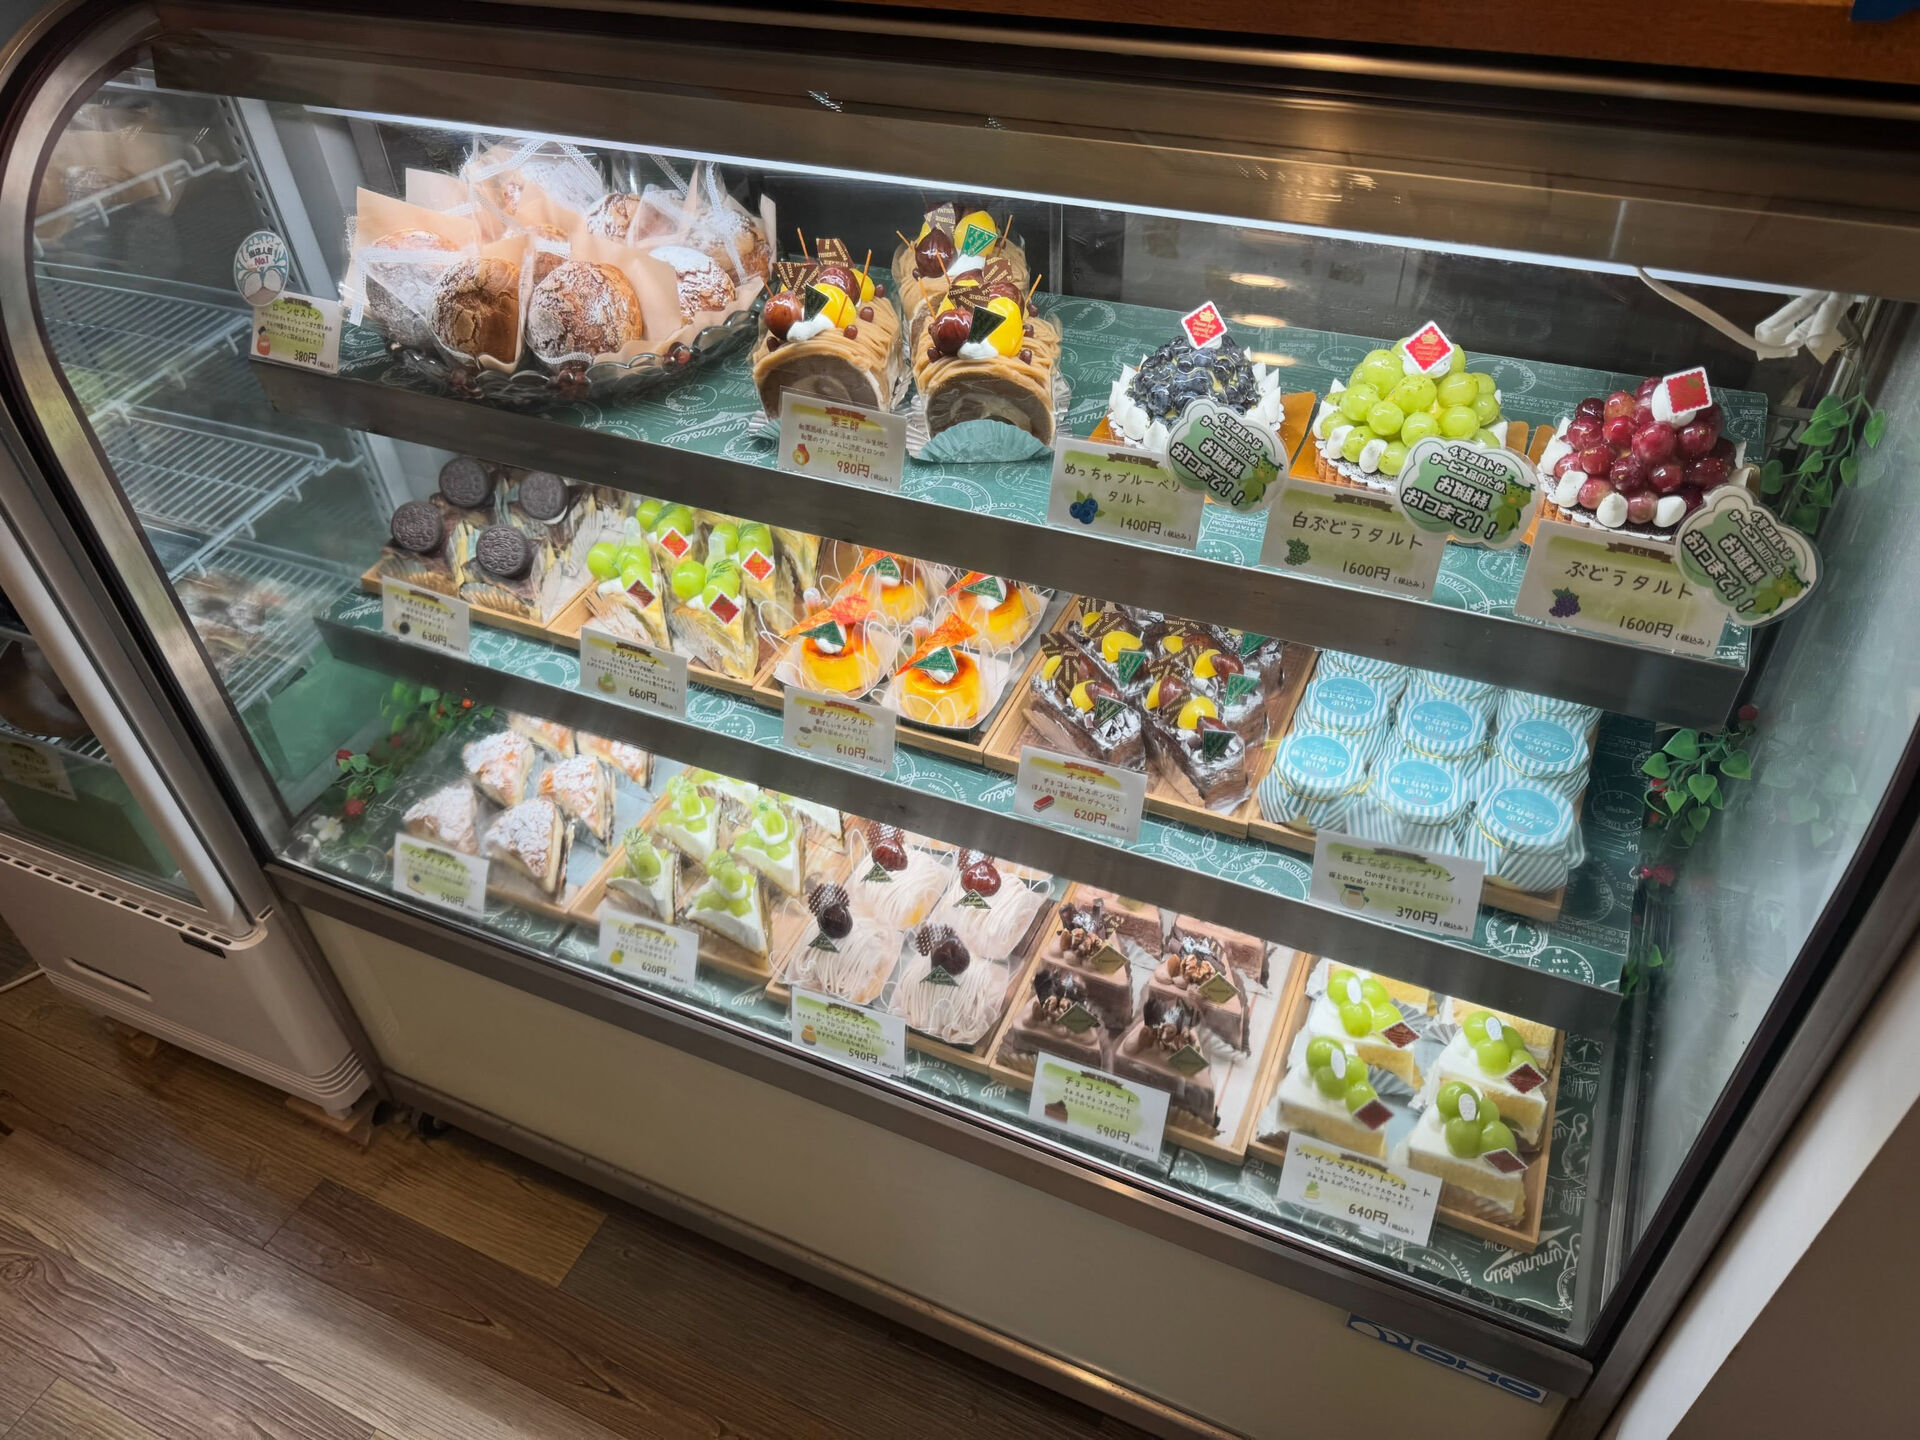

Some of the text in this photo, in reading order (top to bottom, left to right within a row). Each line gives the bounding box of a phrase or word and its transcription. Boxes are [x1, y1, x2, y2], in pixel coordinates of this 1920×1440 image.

[294, 349, 318, 365] 380円
[1217, 413, 1263, 451] 4号タルトは
[837, 460, 870, 478] 980円
[1447, 444, 1507, 477] 4号タルトは
[1108, 490, 1145, 506] タルト
[1120, 516, 1192, 543] 1400円 (税込み)
[1291, 511, 1423, 550] 白ぶどうタルト
[1749, 510, 1795, 562] 4号タルトは
[1341, 560, 1425, 590] 1600円 (税込み)
[1563, 560, 1694, 600] ぶどうタルト
[422, 630, 447, 647] 630円
[1618, 615, 1712, 648] 1600円 (税込み)
[628, 686, 657, 704] 660円
[836, 743, 866, 759] 610円
[1066, 771, 1096, 785] オペラ
[1073, 808, 1107, 826] 620円
[1395, 905, 1438, 926] 370円
[641, 962, 667, 978] 620円
[848, 1048, 878, 1065] 590円
[1064, 1076, 1134, 1104] チョコショート
[1096, 1124, 1130, 1144] 590円
[1294, 1147, 1431, 1198] シャインマスカットショート
[1348, 1203, 1389, 1225] 640円
